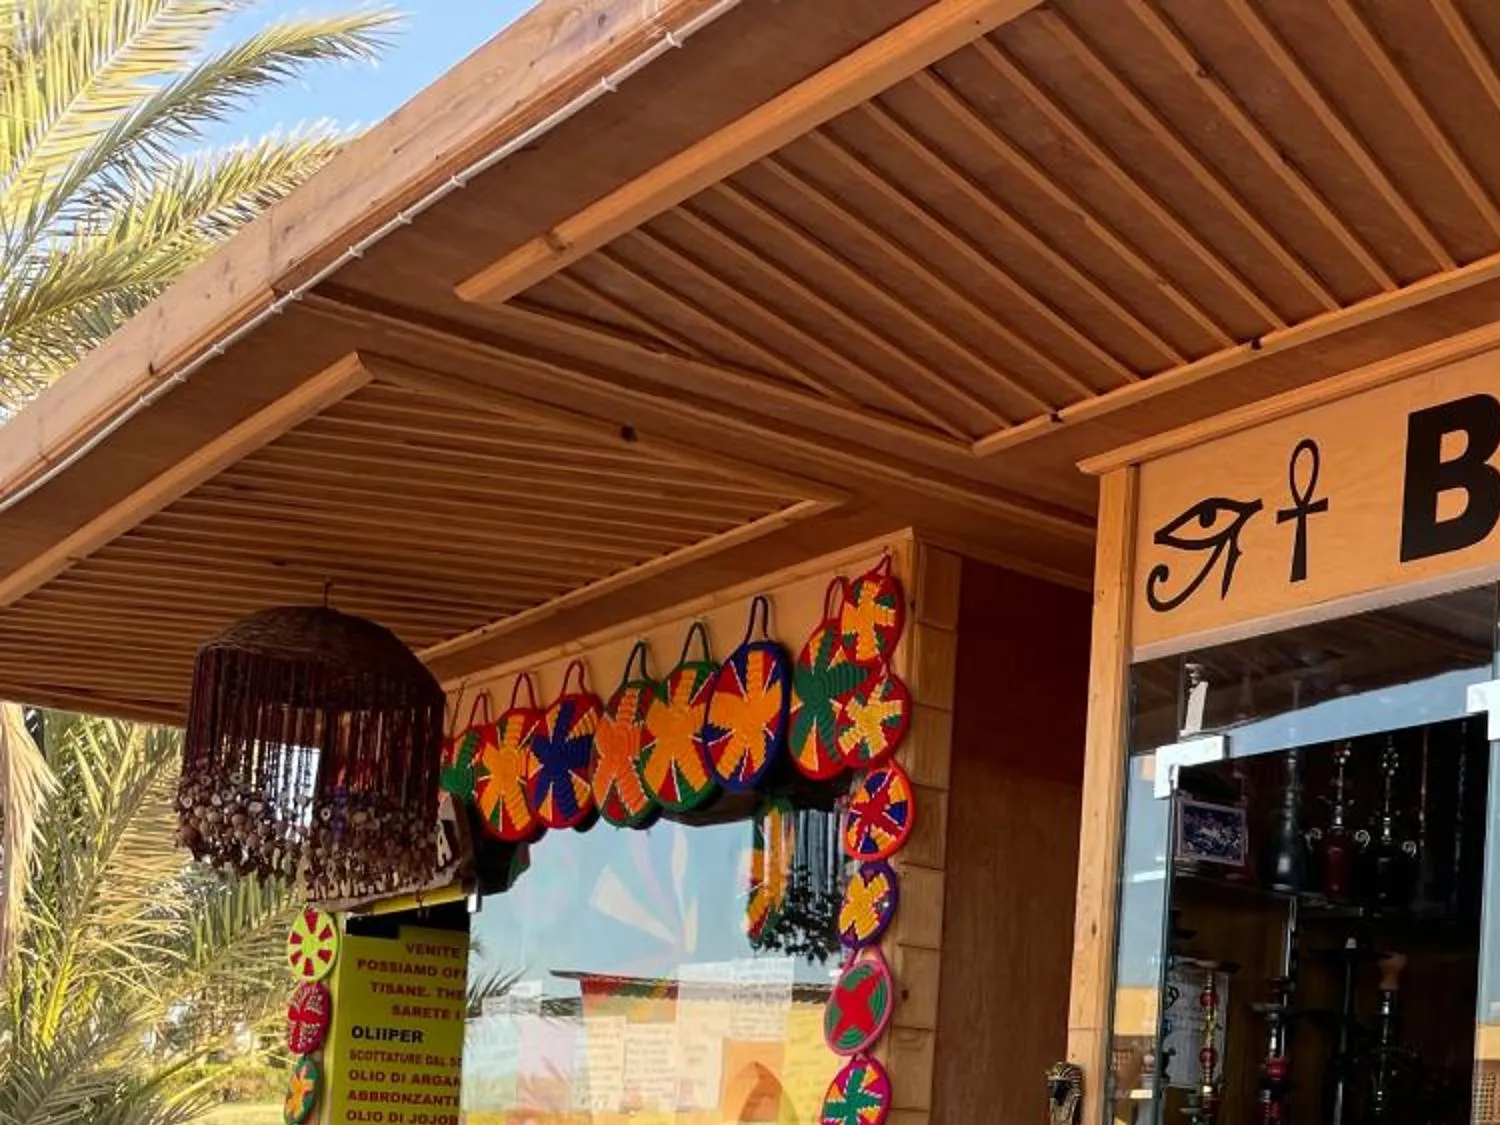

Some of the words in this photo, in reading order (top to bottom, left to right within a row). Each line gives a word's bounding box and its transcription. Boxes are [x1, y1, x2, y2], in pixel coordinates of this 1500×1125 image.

[348, 1069, 386, 1082] OLIO
[391, 1072, 406, 1083] DI
[346, 1109, 383, 1122] OLIO
[388, 1111, 403, 1123] DI
